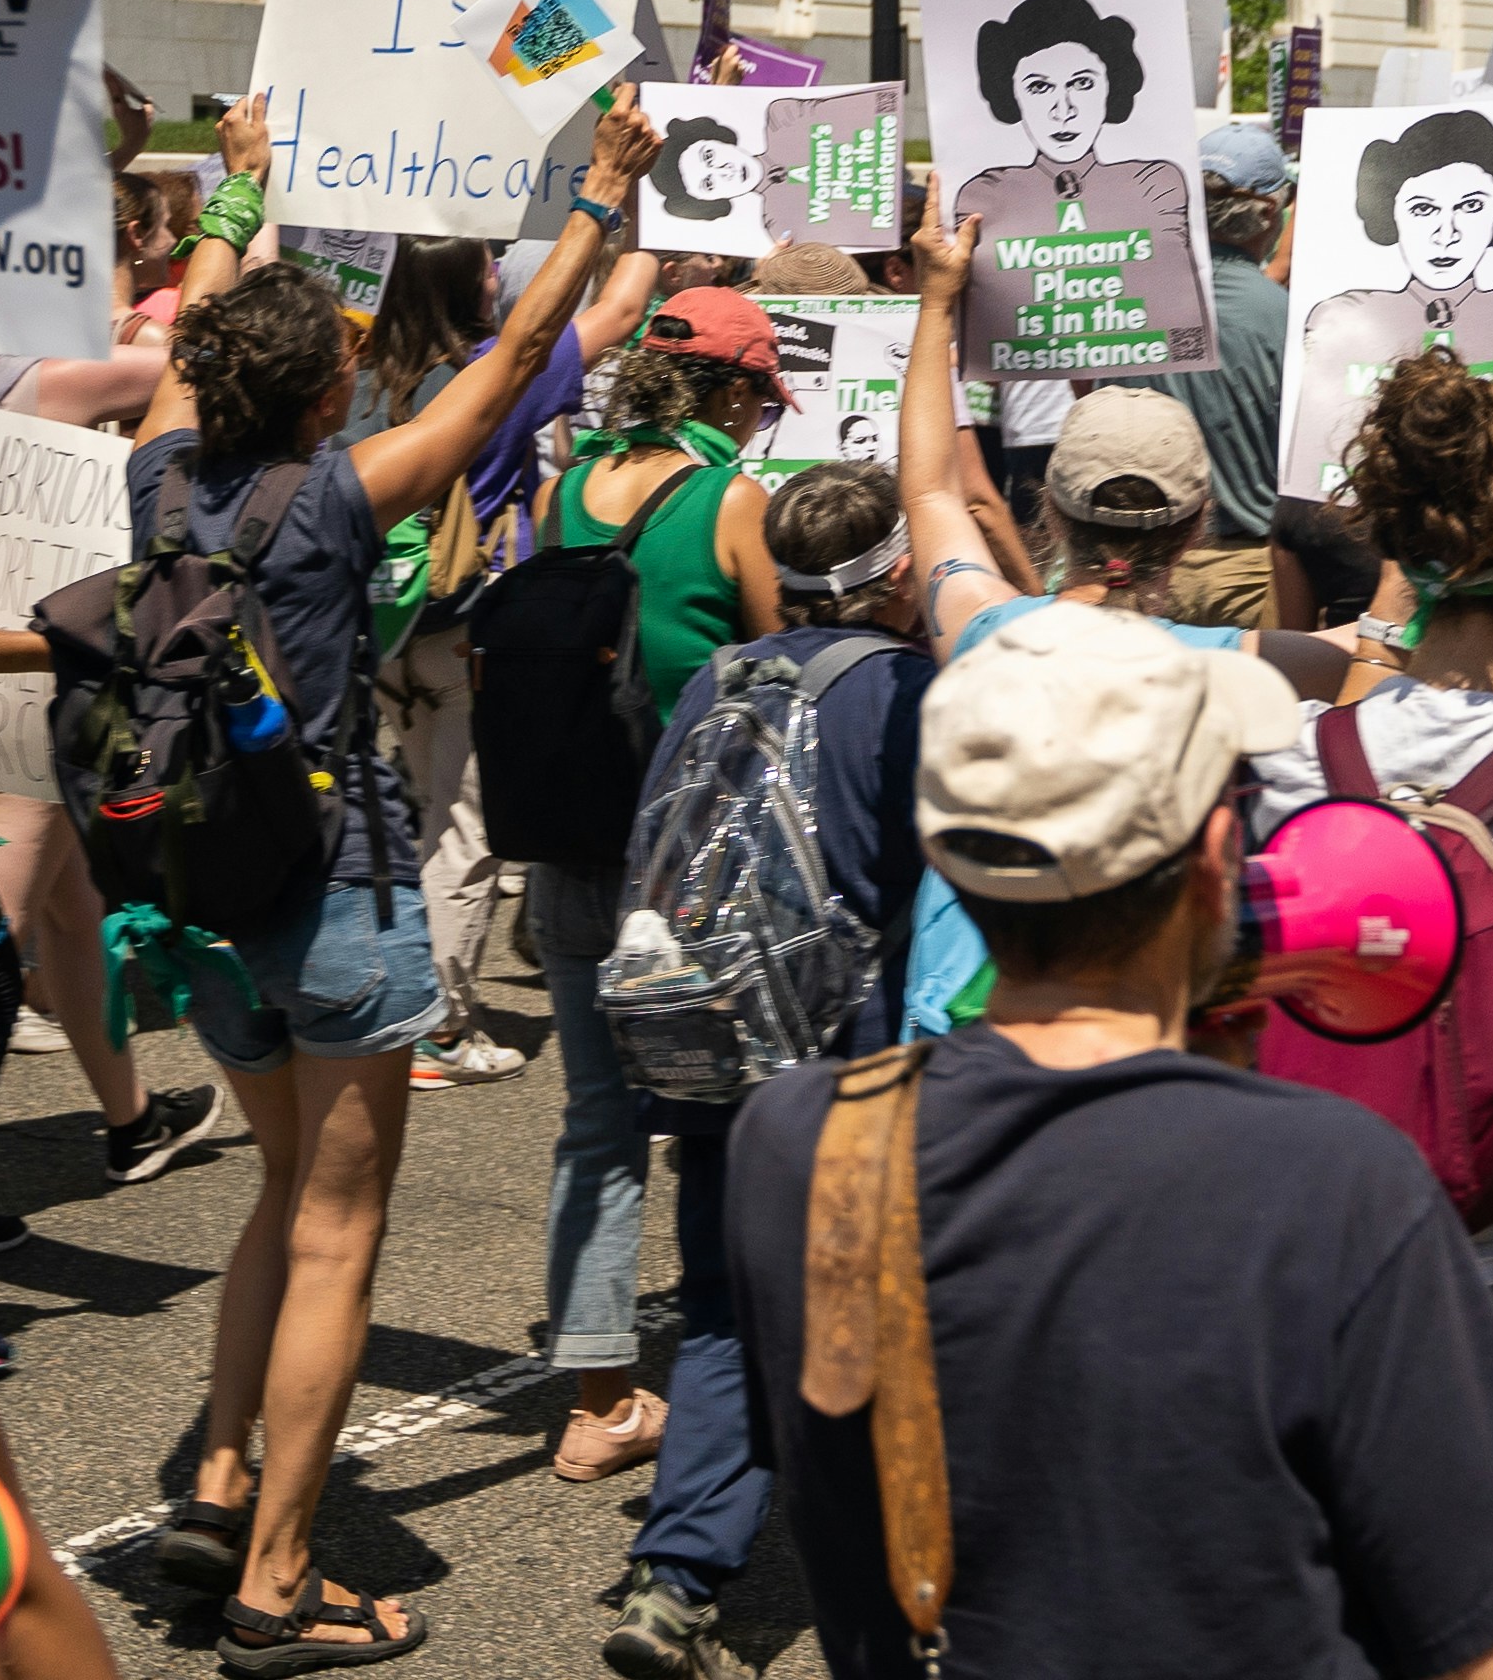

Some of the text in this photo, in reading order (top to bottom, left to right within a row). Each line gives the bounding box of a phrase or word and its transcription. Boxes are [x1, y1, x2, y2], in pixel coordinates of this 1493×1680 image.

[264, 85, 590, 204] Healthcare
[788, 166, 810, 183] A
[809, 124, 833, 224] Woman's
[831, 143, 854, 199] Place
[850, 128, 876, 211] is in the
[871, 114, 898, 228] Resistance
[1058, 202, 1088, 233] A
[996, 231, 1153, 269] Woman's
[1034, 269, 1124, 303] Place
[795, 299, 834, 314] STILL
[836, 300, 860, 314] the
[1017, 299, 1148, 336] is in the
[991, 337, 1170, 370] Resistance
[838, 379, 898, 412] The
